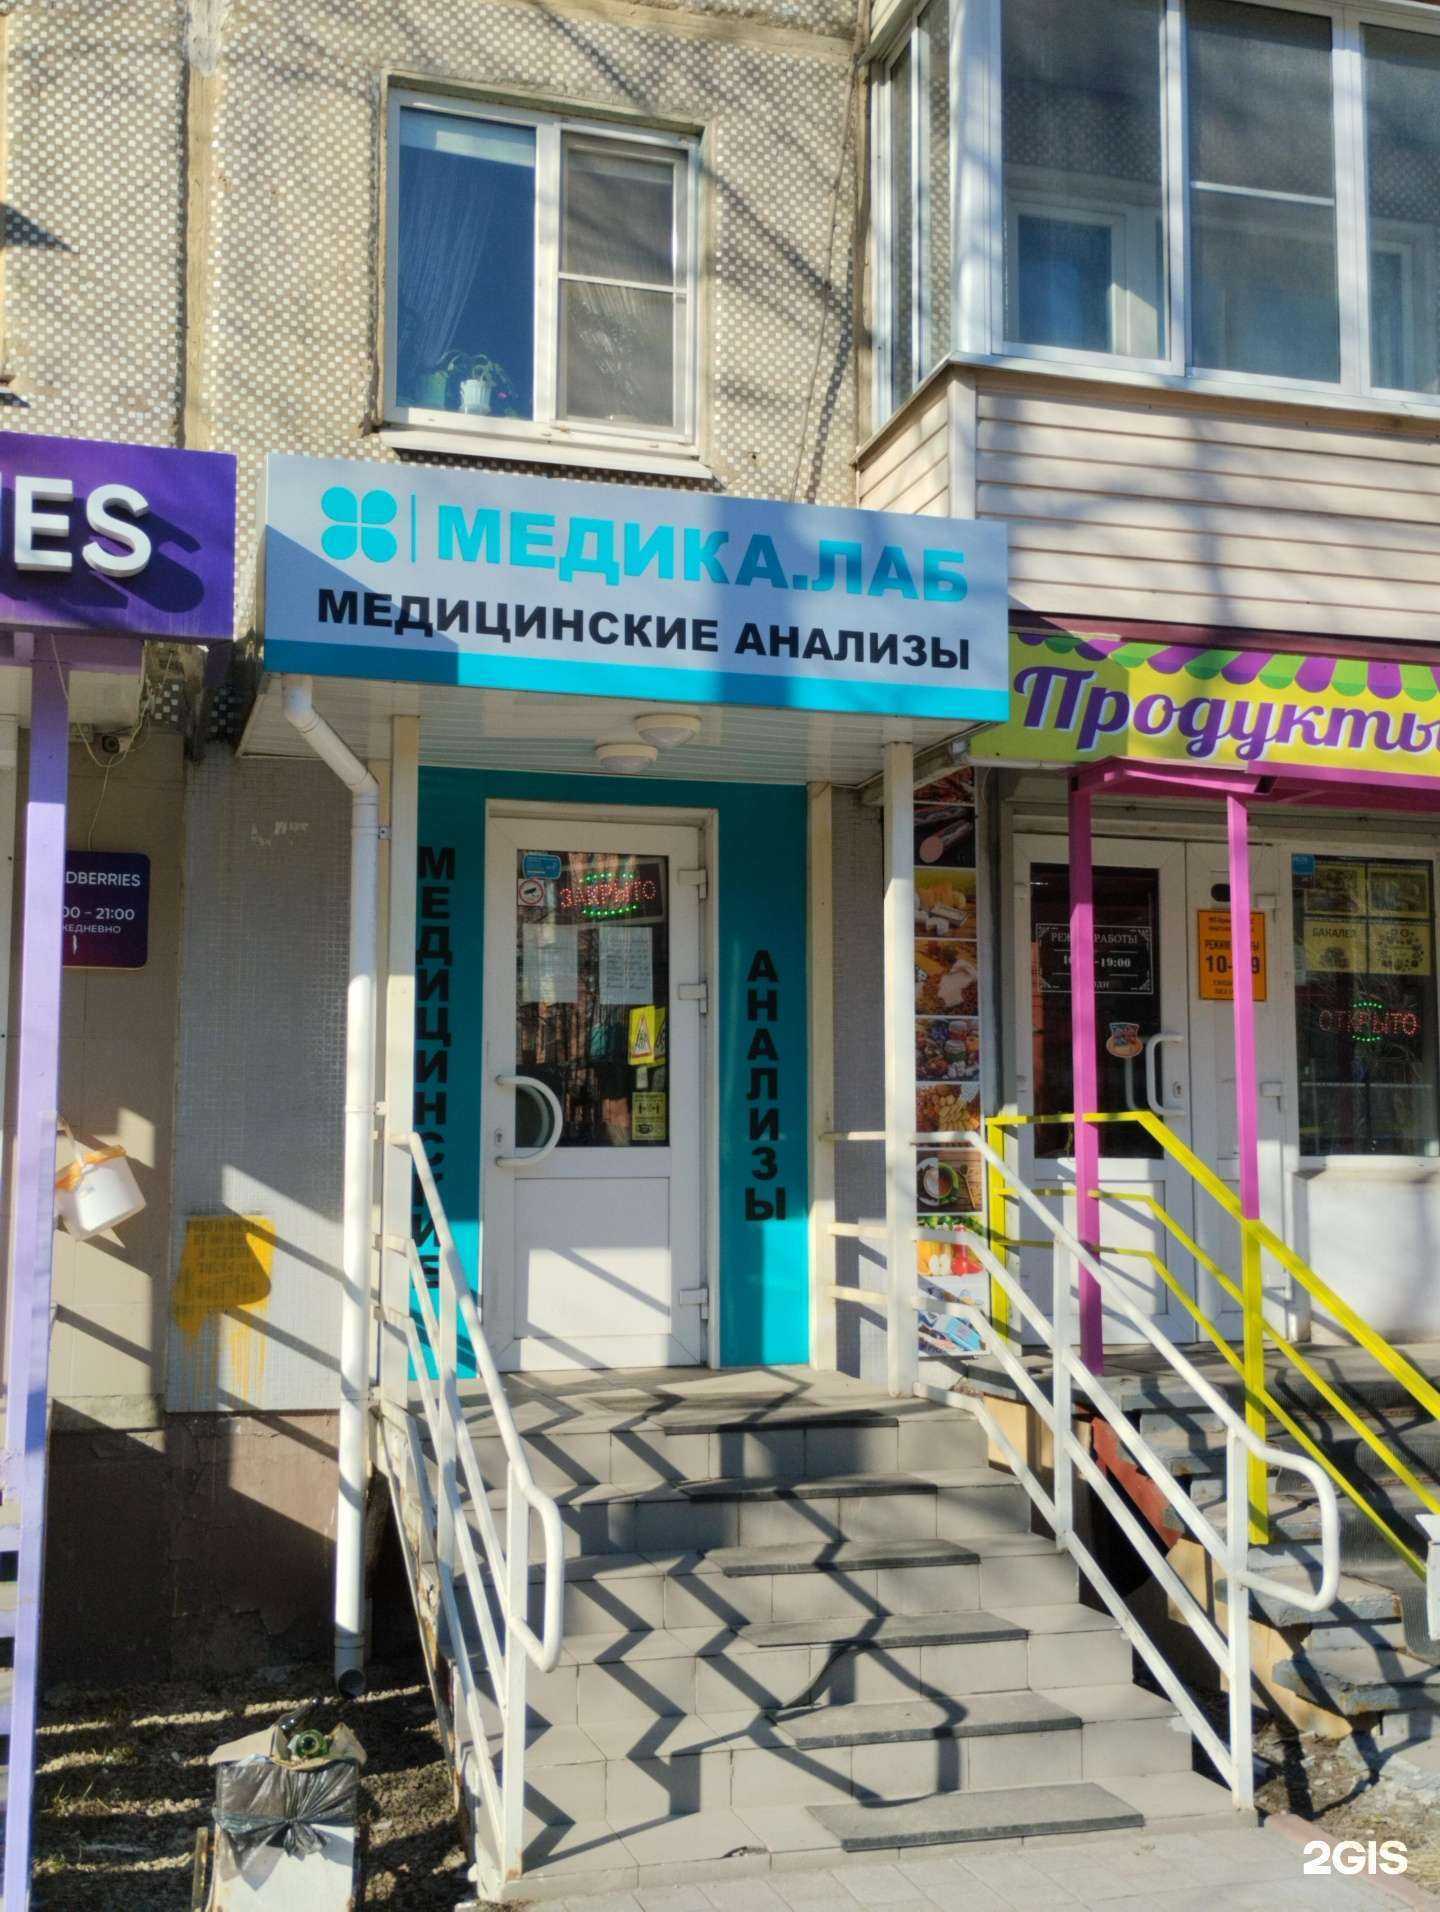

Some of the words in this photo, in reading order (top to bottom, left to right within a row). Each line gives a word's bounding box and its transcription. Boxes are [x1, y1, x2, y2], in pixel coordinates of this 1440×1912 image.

[0, 476, 153, 578] ES
[437, 504, 969, 603] МЕДИКА.ЛАБ
[317, 588, 719, 653] МЕДИЦИНСКИЕ
[734, 622, 970, 670] АНАЛИЗЫ
[1014, 666, 1440, 760] Продукты
[95, 907, 135, 920] 21:00
[1094, 934, 1138, 945] РАБОТЫ
[745, 949, 787, 1221] АНАЛИЗЫ
